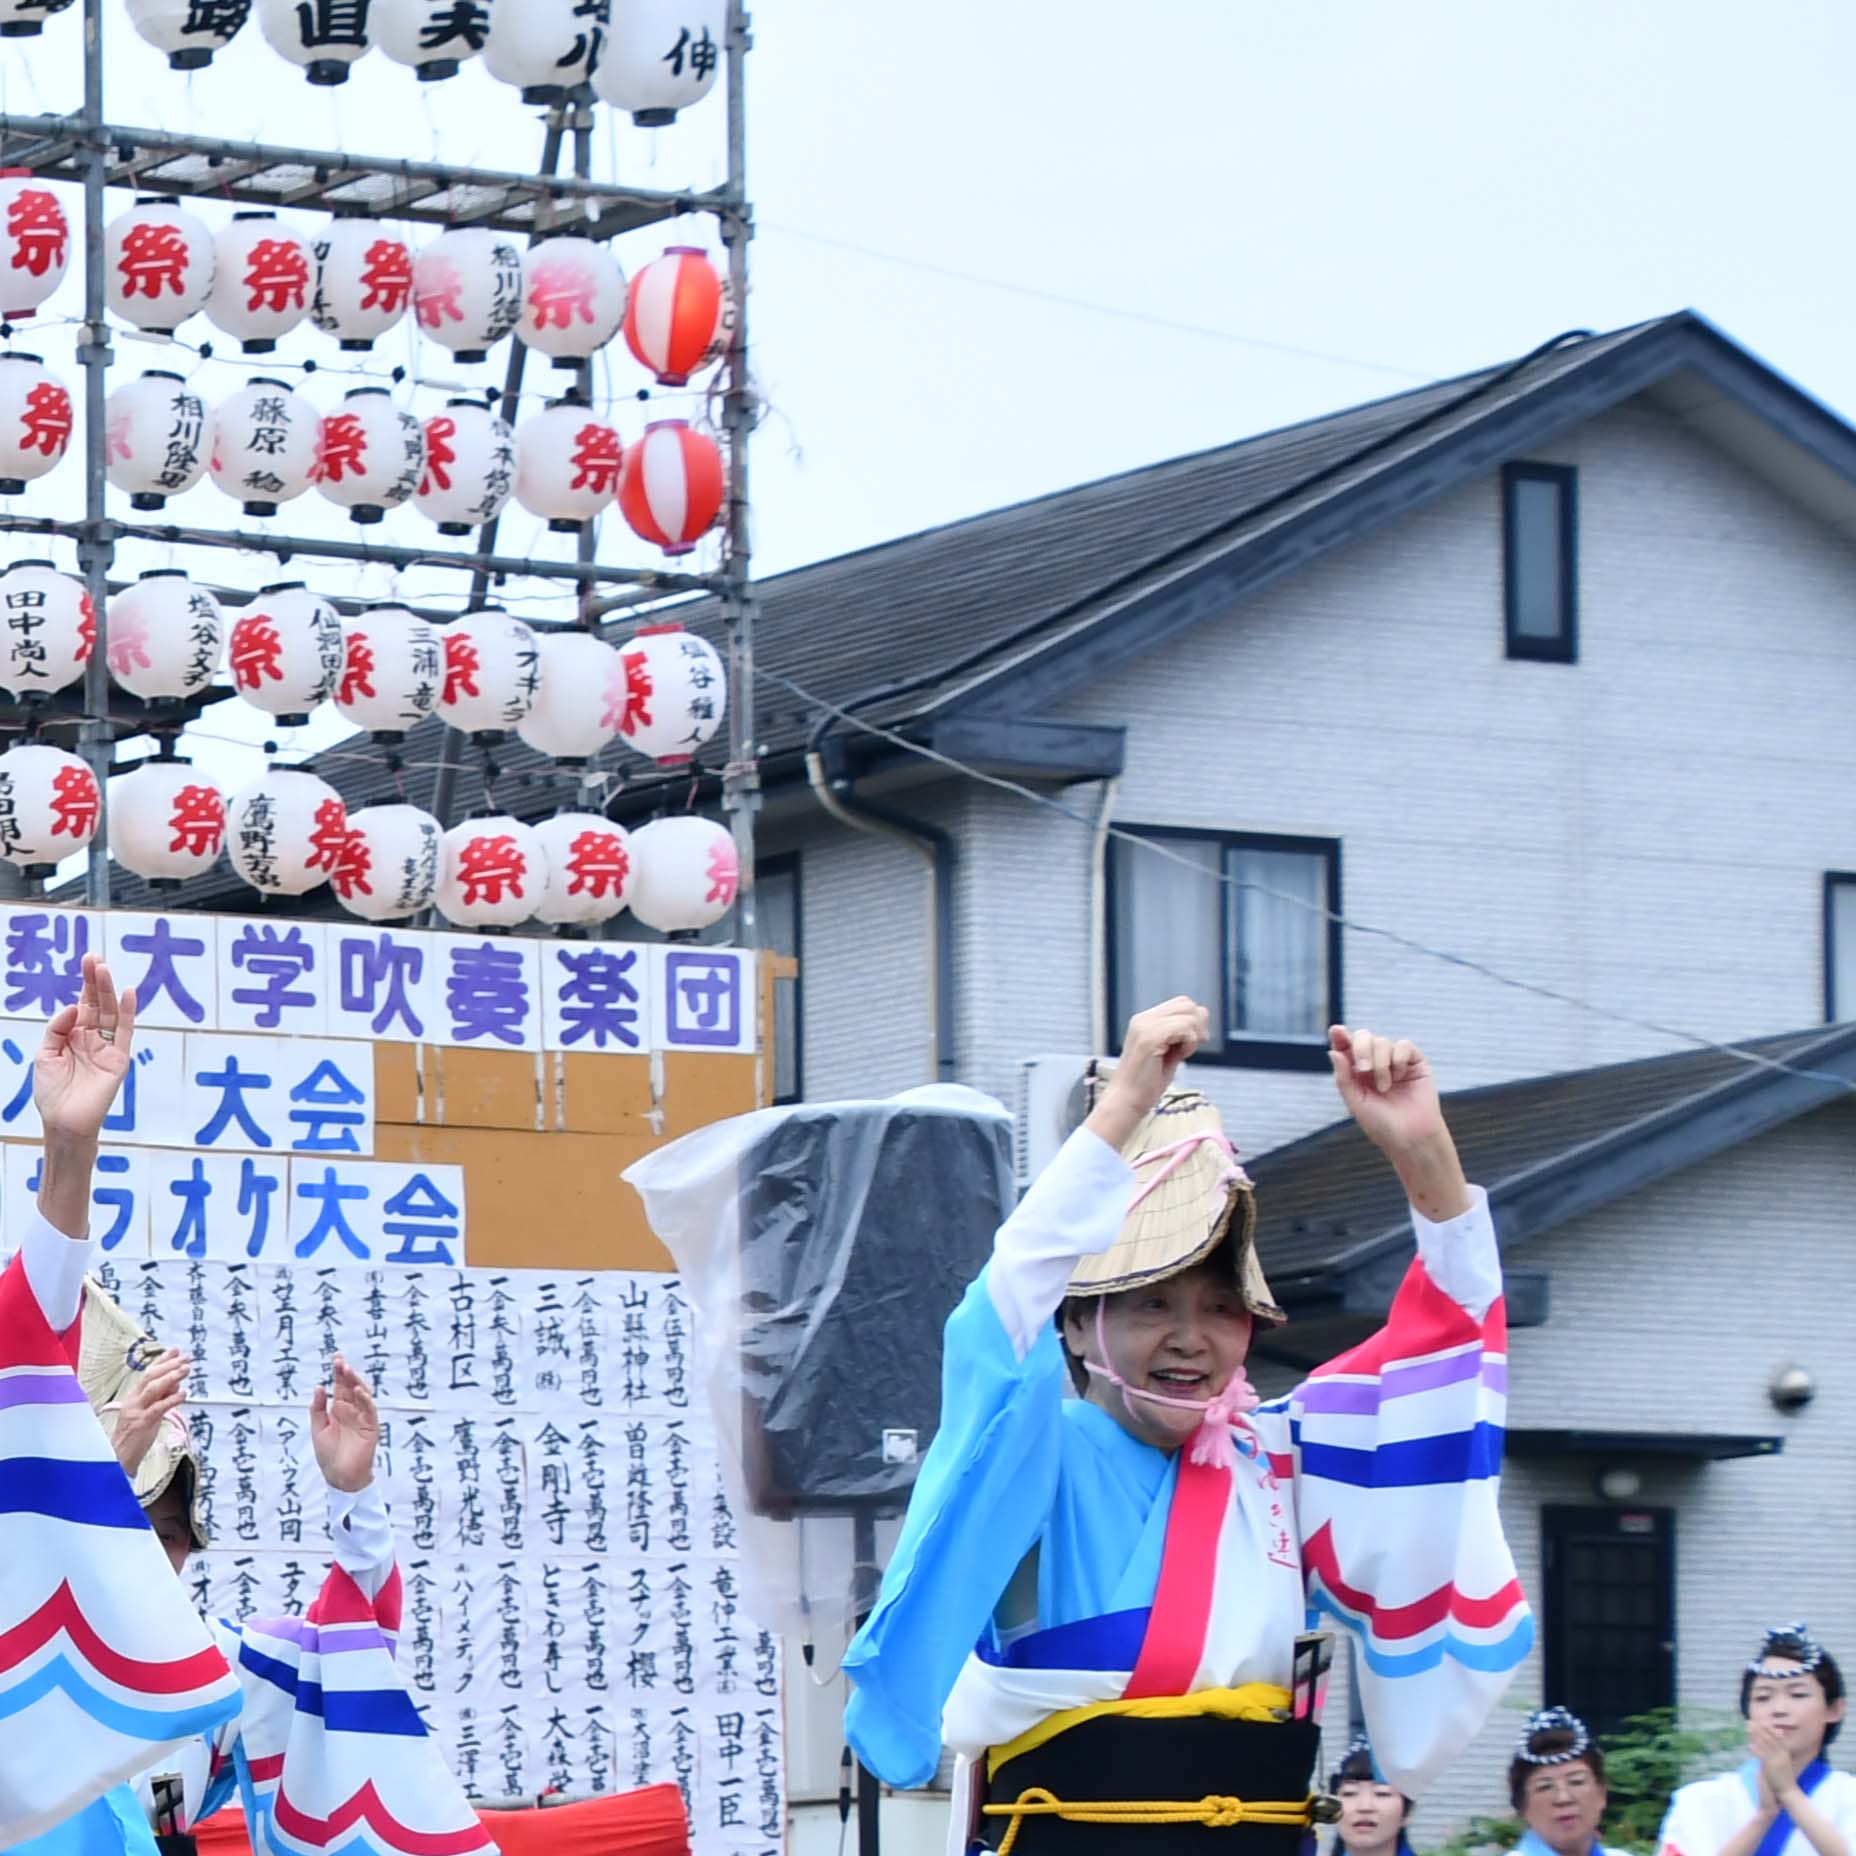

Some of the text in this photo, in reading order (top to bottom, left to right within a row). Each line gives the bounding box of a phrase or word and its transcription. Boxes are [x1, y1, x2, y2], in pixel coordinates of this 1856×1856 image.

[9, 191, 66, 275] 祭
[118, 224, 189, 299] 祭
[244, 240, 309, 313] 祭
[361, 240, 413, 314] 祭
[19, 384, 71, 456] 祭
[570, 425, 622, 492] 祭
[5, 590, 51, 679] 田中尚人
[169, 785, 225, 857] 祭
[456, 836, 526, 906] 祭
[567, 831, 629, 899] 祭
[26, 1155, 459, 1266] ラオケ大会
[447, 1271, 481, 1391] 古村区
[535, 1422, 572, 1546] 金剛寺
